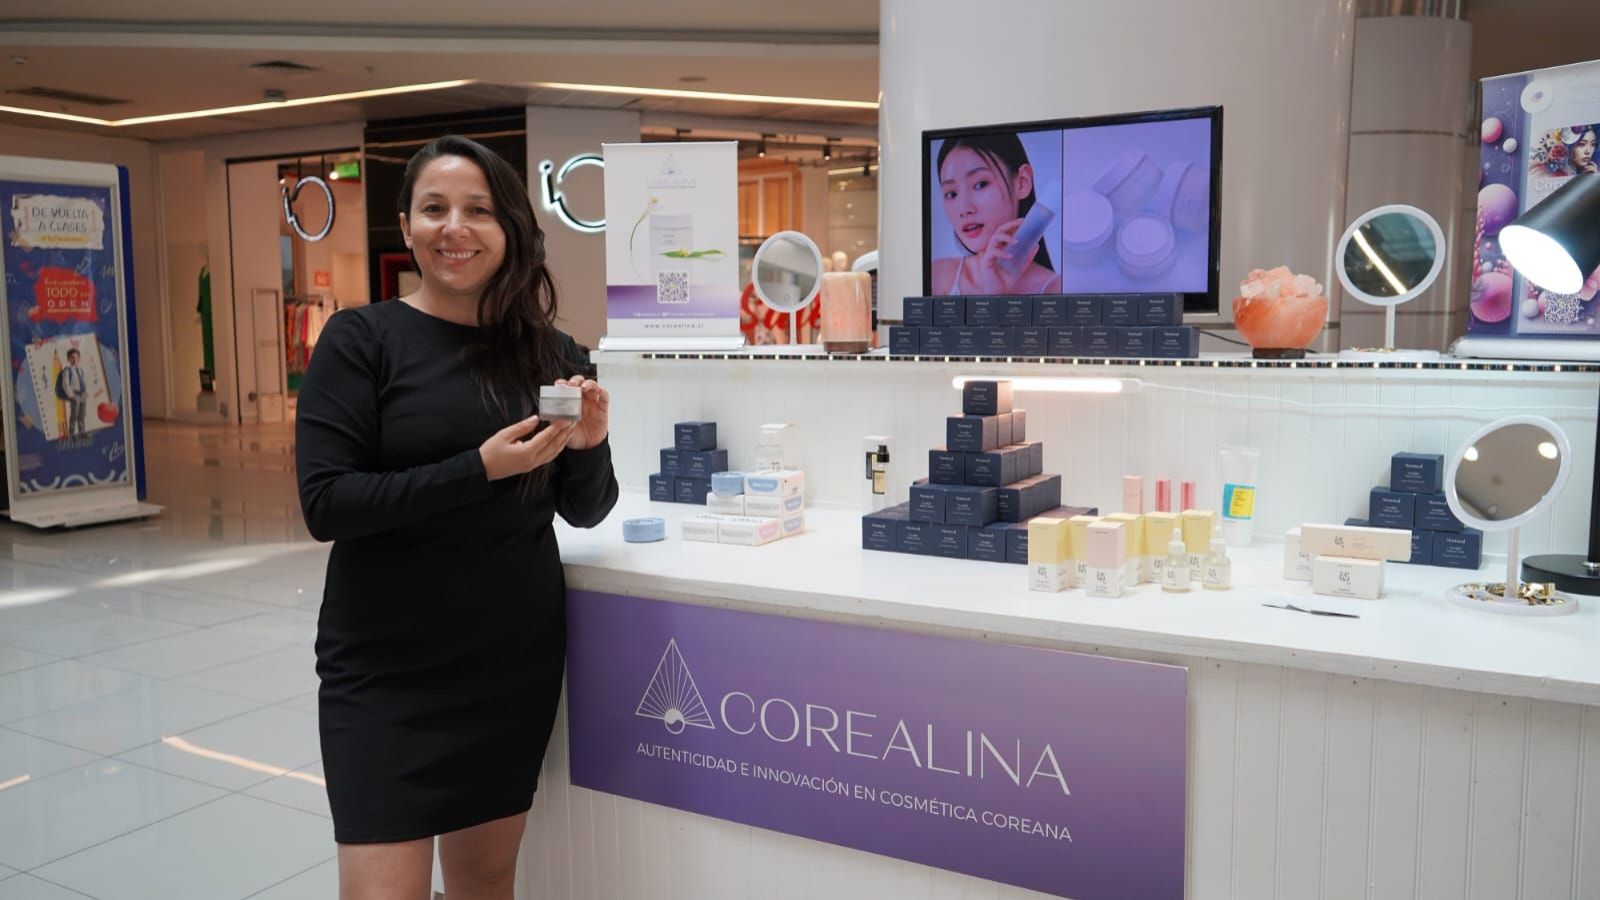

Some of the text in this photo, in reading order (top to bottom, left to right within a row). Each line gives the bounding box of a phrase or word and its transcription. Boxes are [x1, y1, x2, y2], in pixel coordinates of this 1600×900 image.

[31, 207, 88, 220] DE VUELTA
[38, 220, 87, 233] A CLASES
[47, 287, 78, 298] TODO
[47, 299, 89, 309] OPEN
[720, 691, 1071, 795] COREALINA
[636, 742, 1073, 843] AUTENTICIDAD E INNOVACIÓN EN COSMÉTICA COREANA
